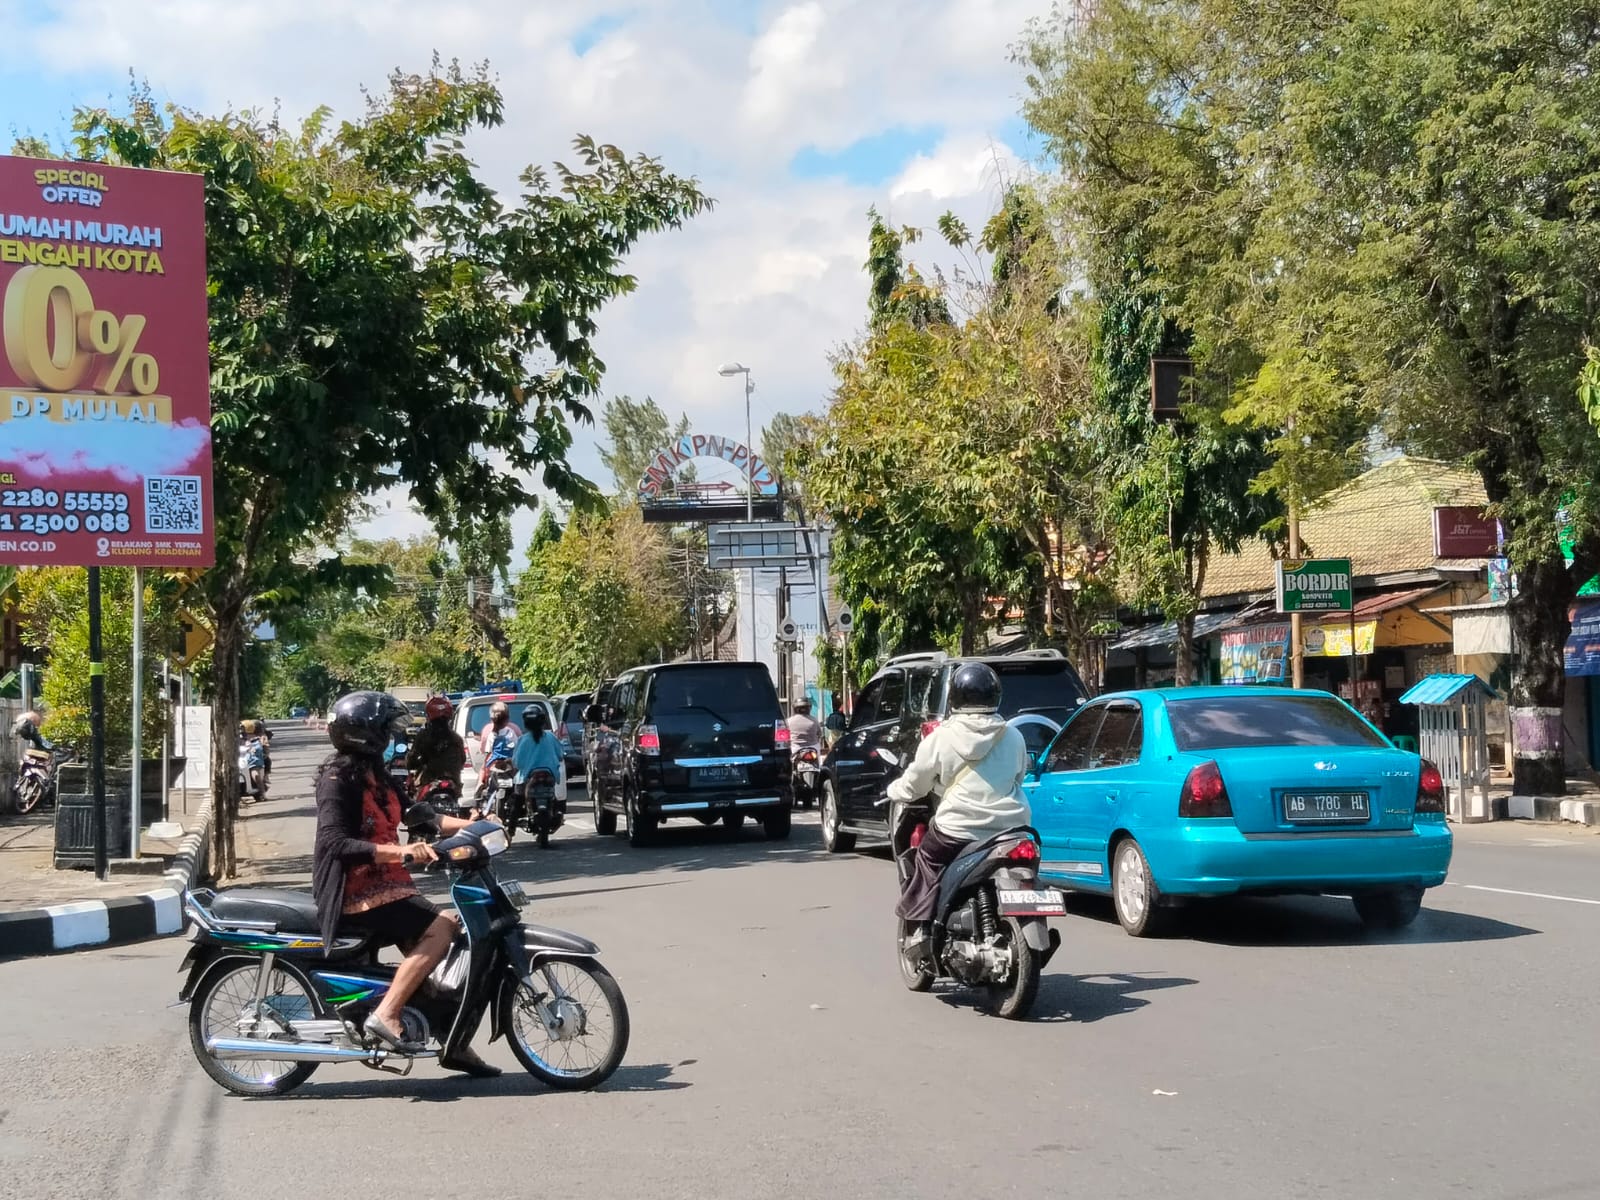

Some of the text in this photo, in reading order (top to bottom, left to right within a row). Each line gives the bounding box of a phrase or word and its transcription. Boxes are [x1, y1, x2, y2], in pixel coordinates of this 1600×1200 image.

[34, 169, 109, 191] SPECIAL
[43, 186, 103, 207] OFFER
[75, 220, 162, 247] MURAH
[95, 248, 164, 274] KOTA
[4, 265, 159, 395] 0%
[11, 396, 157, 423] DP MULAI
[639, 440, 688, 495] SMK
[2, 488, 128, 511] 2280 55559
[20, 514, 79, 534] 2500
[85, 512, 130, 532] 088
[1450, 525, 1473, 535] J&T
[0, 540, 56, 552] EN.CO.ID
[111, 548, 152, 556] KLEDUNG
[1285, 573, 1349, 592] BORDIR
[1291, 796, 1305, 812] AB
